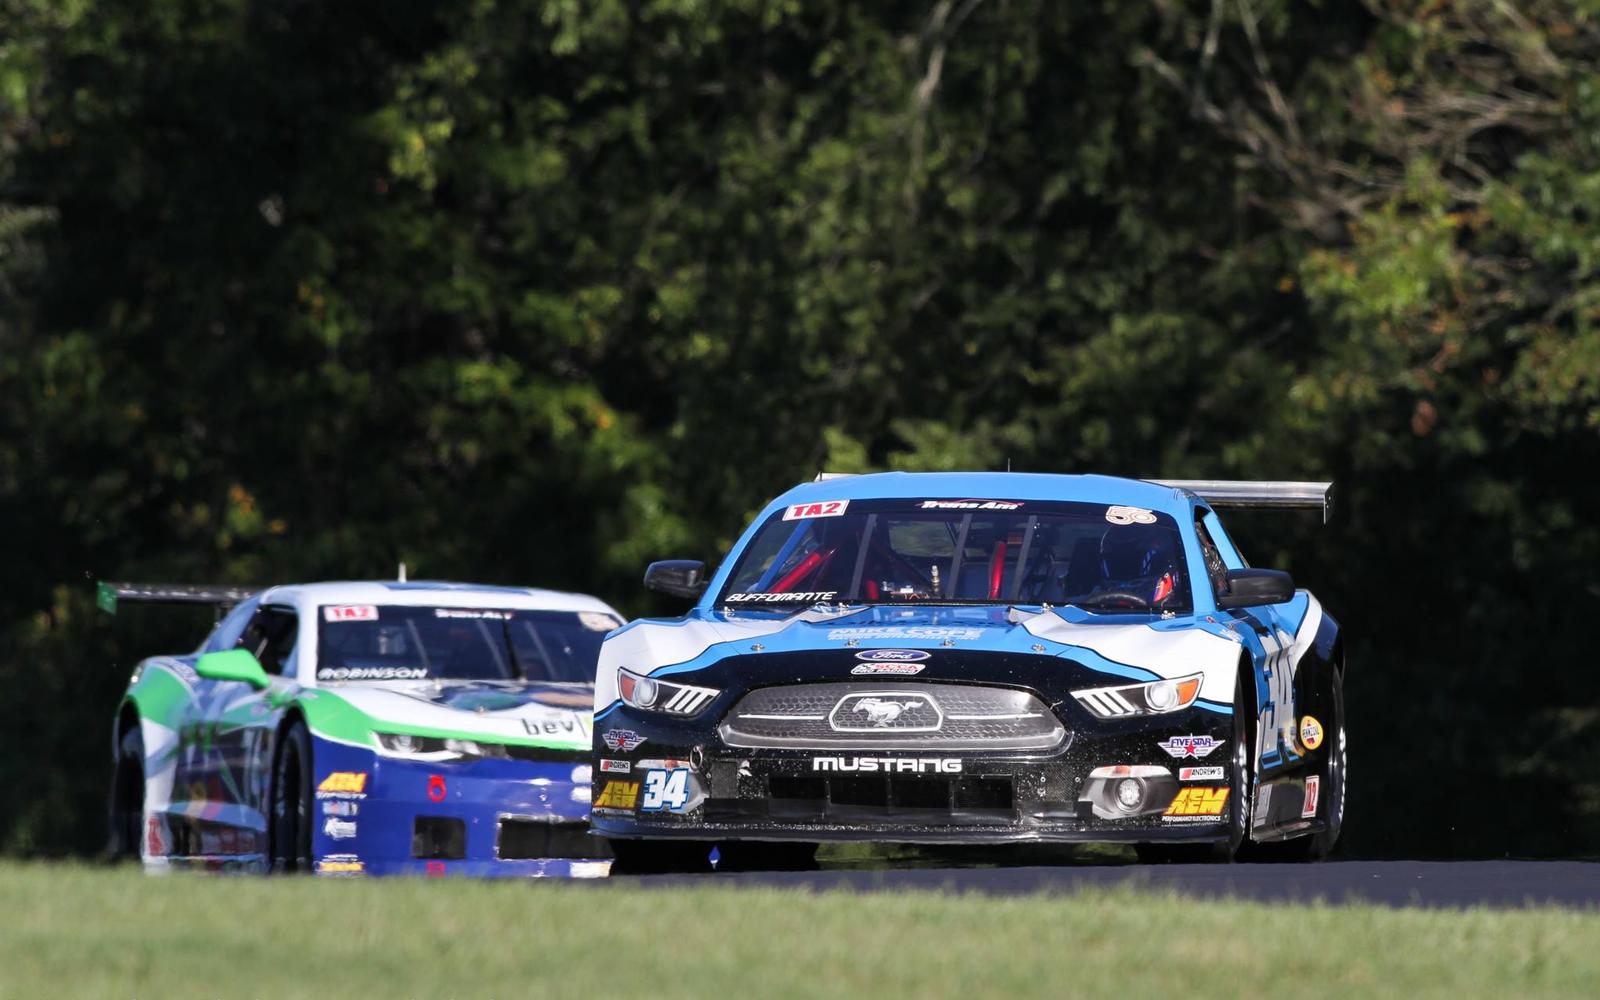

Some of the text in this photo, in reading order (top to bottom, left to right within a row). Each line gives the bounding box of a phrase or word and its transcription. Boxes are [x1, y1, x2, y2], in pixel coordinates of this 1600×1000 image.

[793, 502, 841, 518] TA2
[921, 500, 1018, 510] Trans Am
[725, 591, 837, 602] BUFFOMANTE
[872, 651, 914, 660] Ford
[317, 667, 428, 680] ROBINSON
[1170, 737, 1212, 748] FIVE STAR
[813, 757, 963, 773] MUSTANG
[593, 780, 640, 809] AEM
[642, 768, 689, 812] 34
[1163, 786, 1231, 816] AEM
